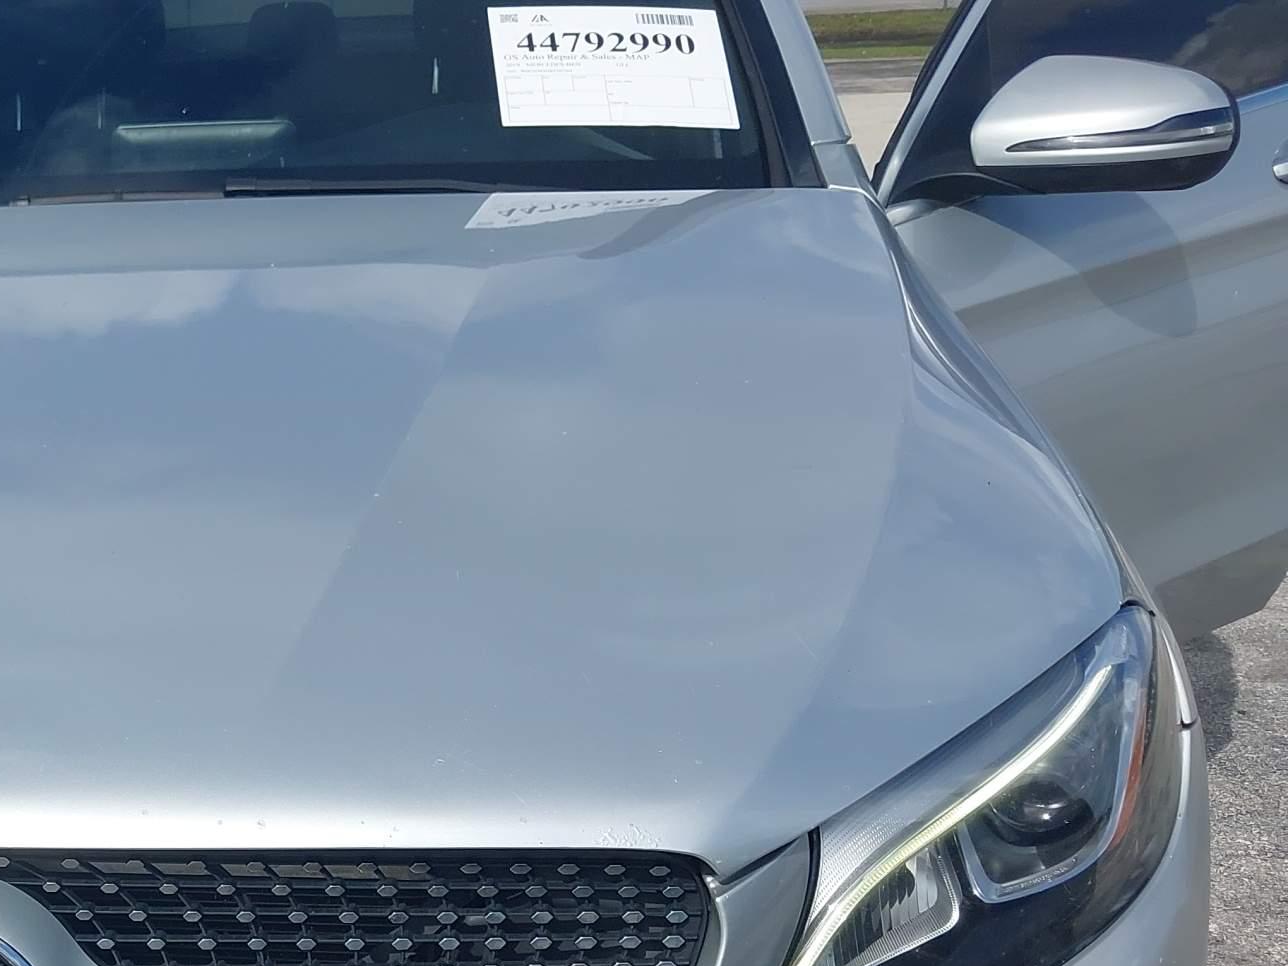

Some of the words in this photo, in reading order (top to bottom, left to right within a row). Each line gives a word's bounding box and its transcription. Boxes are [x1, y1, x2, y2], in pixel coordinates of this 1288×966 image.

[516, 31, 695, 55] 44792990
[521, 53, 545, 61] Auto
[547, 53, 578, 62] Repair
